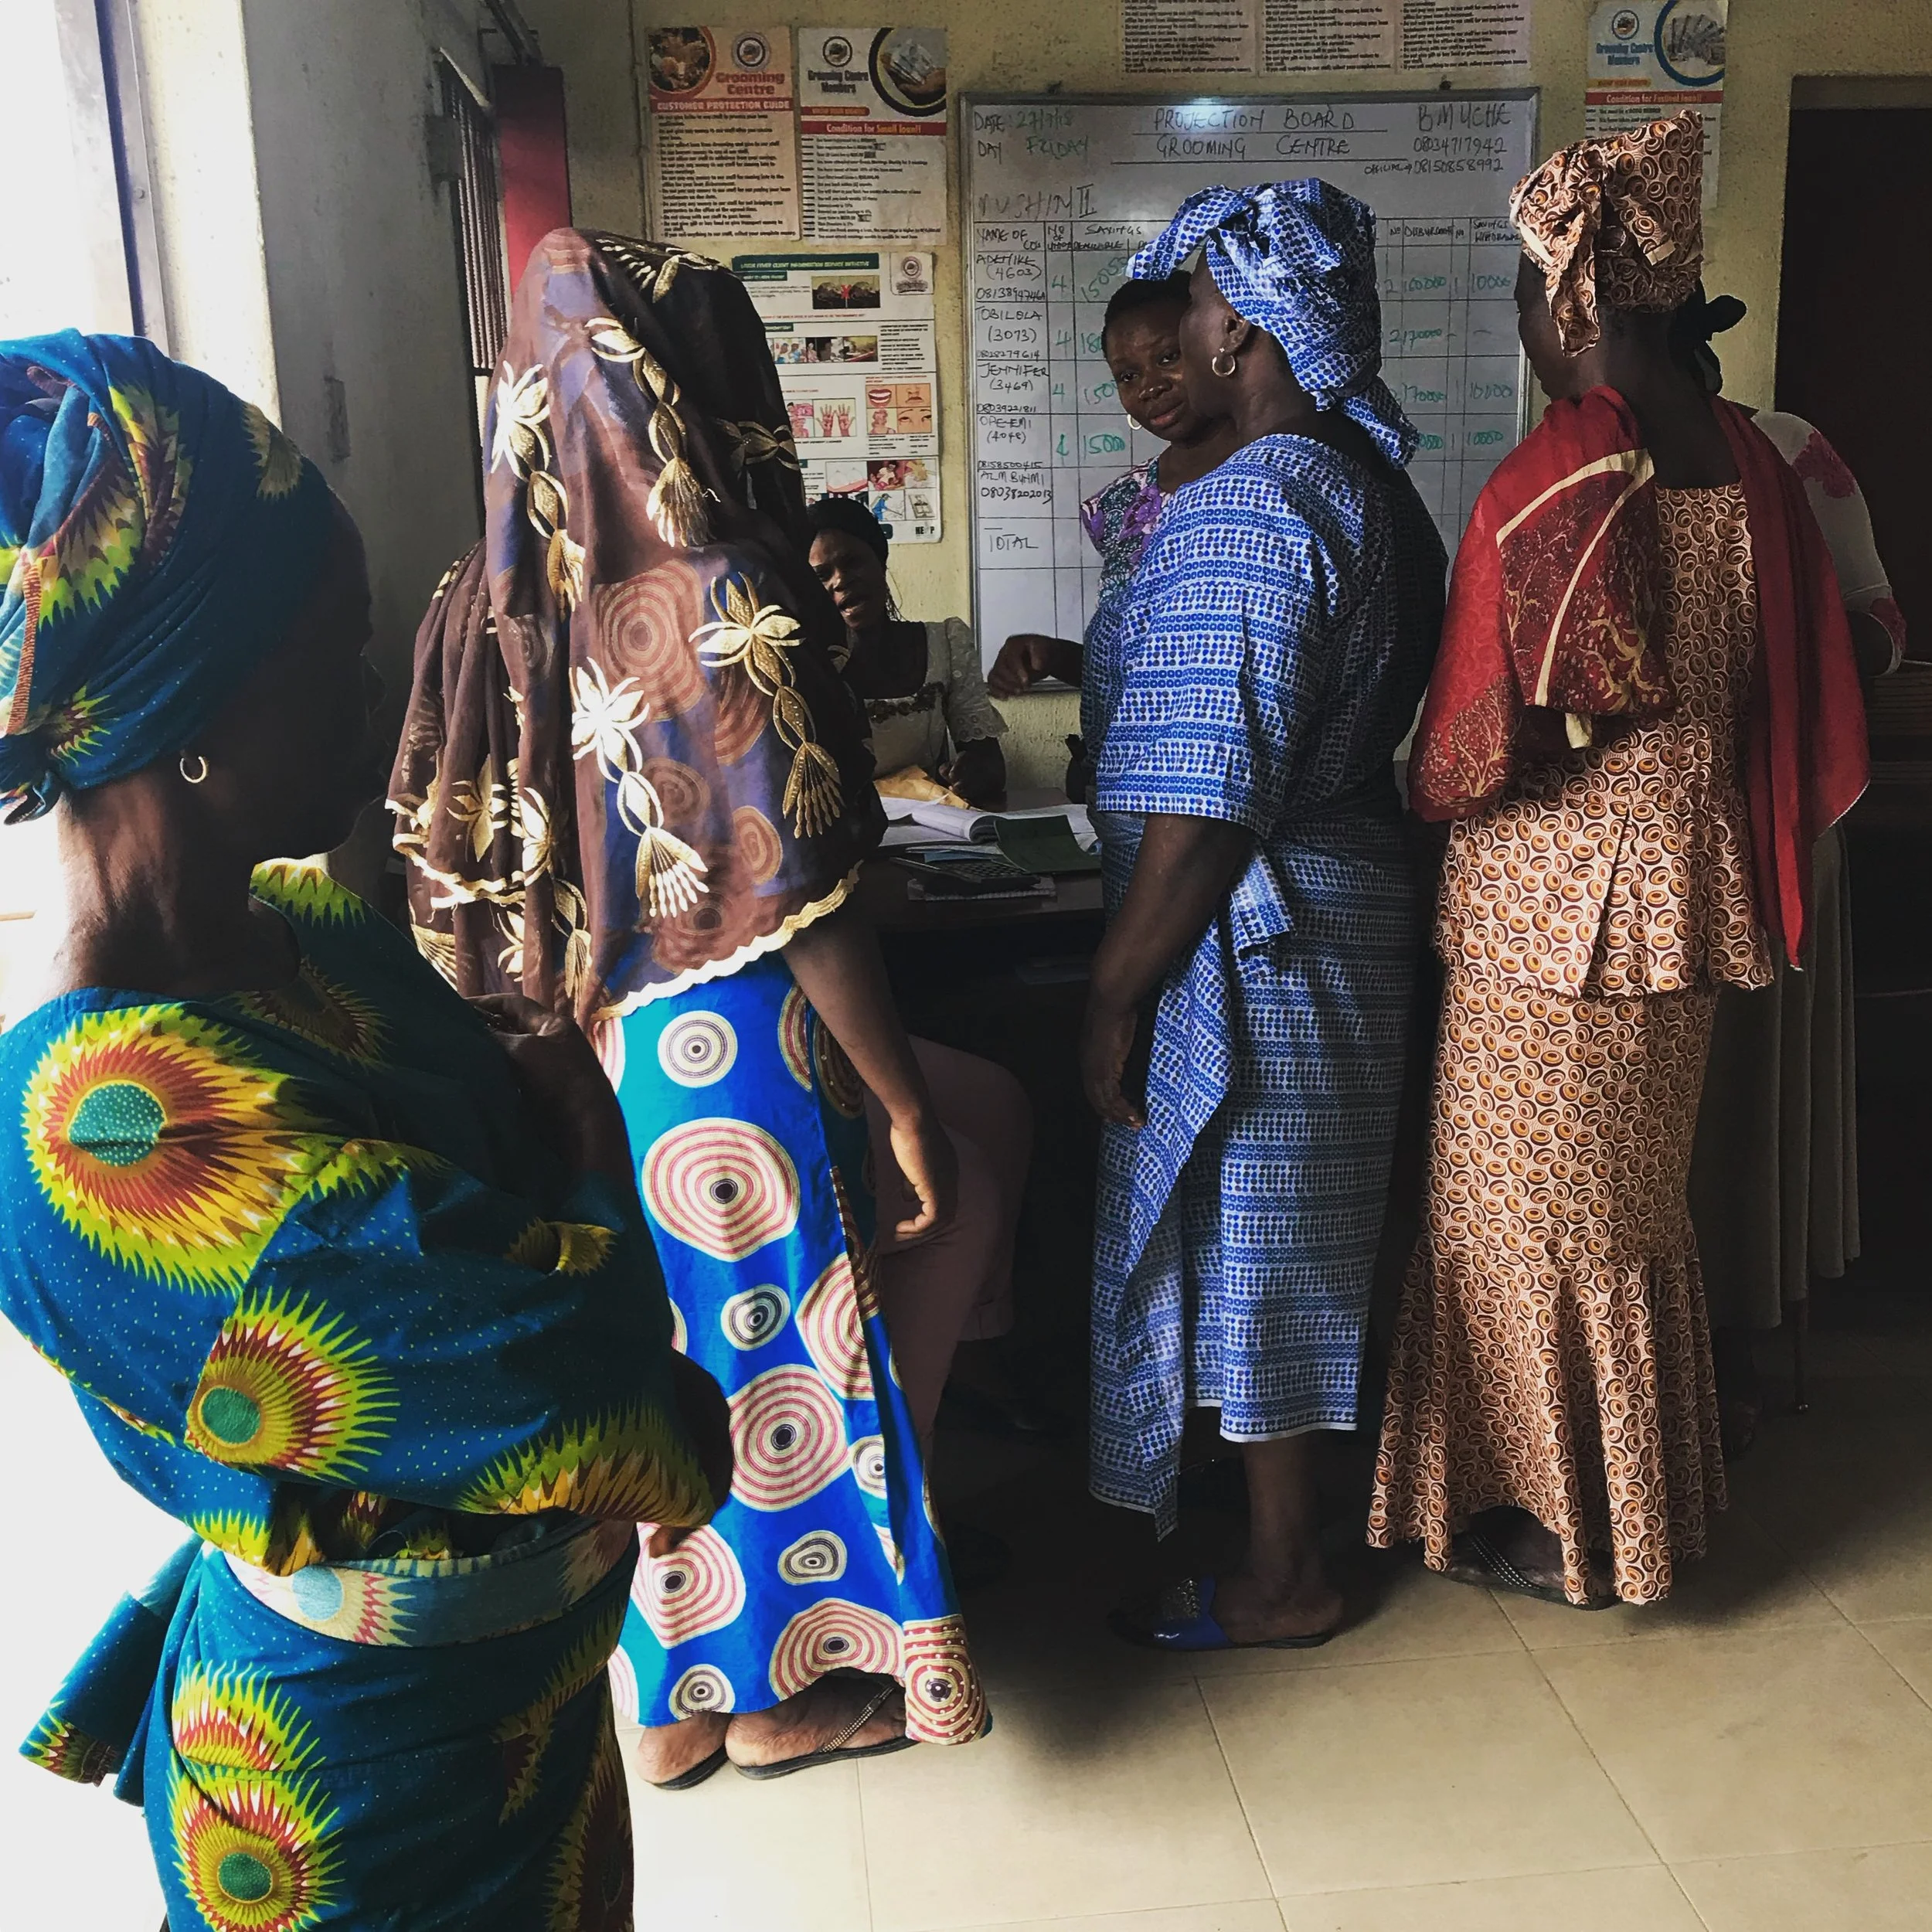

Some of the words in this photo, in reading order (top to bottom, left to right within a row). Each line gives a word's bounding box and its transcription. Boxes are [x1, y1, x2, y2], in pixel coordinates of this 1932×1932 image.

[716, 73, 785, 84] Grooming
[727, 84, 775, 94] Centre
[707, 101, 760, 110] PROTECTION
[764, 100, 790, 109] GUIDE
[1154, 106, 1265, 131] PROJECTION
[1284, 103, 1355, 130] BOARD
[826, 124, 863, 133] Condition
[864, 124, 875, 133] for
[978, 139, 1002, 165] DAY
[1026, 135, 1089, 160] FRIDAY
[1157, 134, 1247, 160] GROOMING
[1276, 134, 1351, 156] CENTRE
[1012, 229, 1029, 241] OF
[986, 264, 1043, 281] (4603)
[1051, 274, 1067, 293] 4
[988, 325, 1037, 343] (3073)
[978, 362, 1049, 379] JENNIFER
[989, 378, 1034, 394] (3469)
[983, 527, 1039, 553] TOTAL
